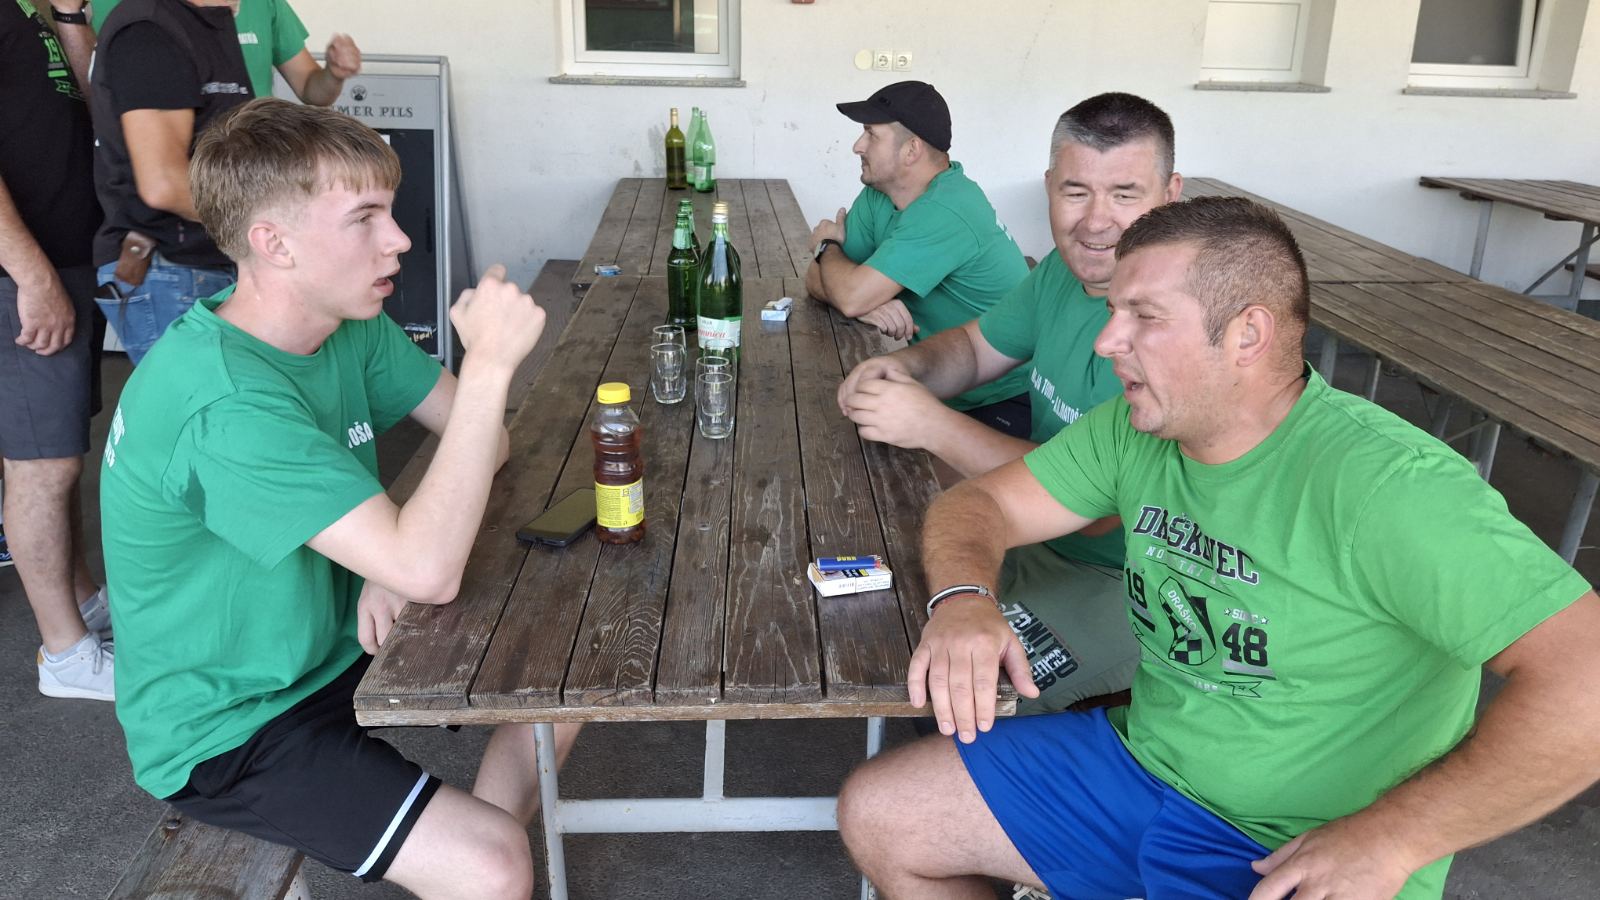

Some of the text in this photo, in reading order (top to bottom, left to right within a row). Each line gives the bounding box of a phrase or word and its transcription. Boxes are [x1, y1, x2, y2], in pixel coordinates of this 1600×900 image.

[379, 106, 414, 118] PILS
[1125, 567, 1148, 610] 19
[1221, 622, 1268, 668] 48
